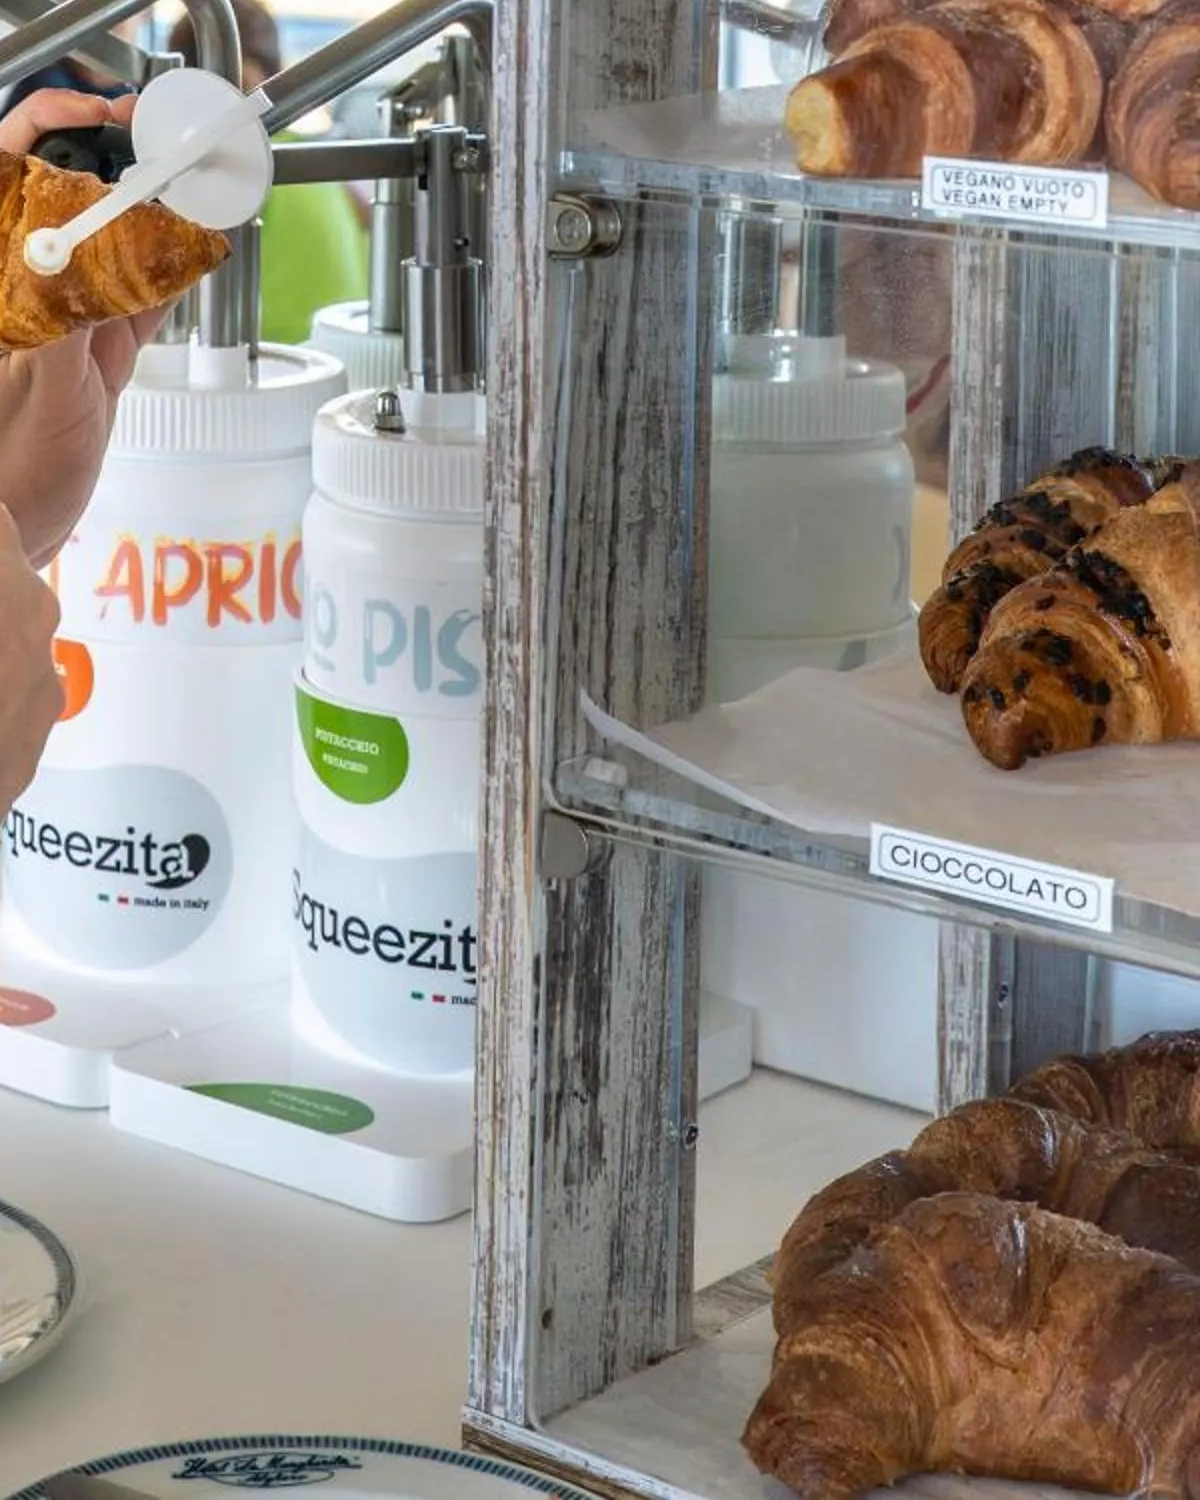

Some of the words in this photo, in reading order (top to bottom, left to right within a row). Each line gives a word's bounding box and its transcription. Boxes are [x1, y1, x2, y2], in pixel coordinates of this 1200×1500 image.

[942, 169, 1016, 191] VEGANO
[1021, 178, 1086, 200] VUOTO
[942, 188, 1001, 207] VEGAN
[1007, 195, 1069, 213] EMPTY
[3, 809, 211, 890] queezita
[890, 844, 1088, 910] CIOCCOLATO
[133, 896, 167, 909] made
[168, 897, 181, 909] in
[182, 897, 210, 911] italy
[293, 867, 477, 974] Squeezit
